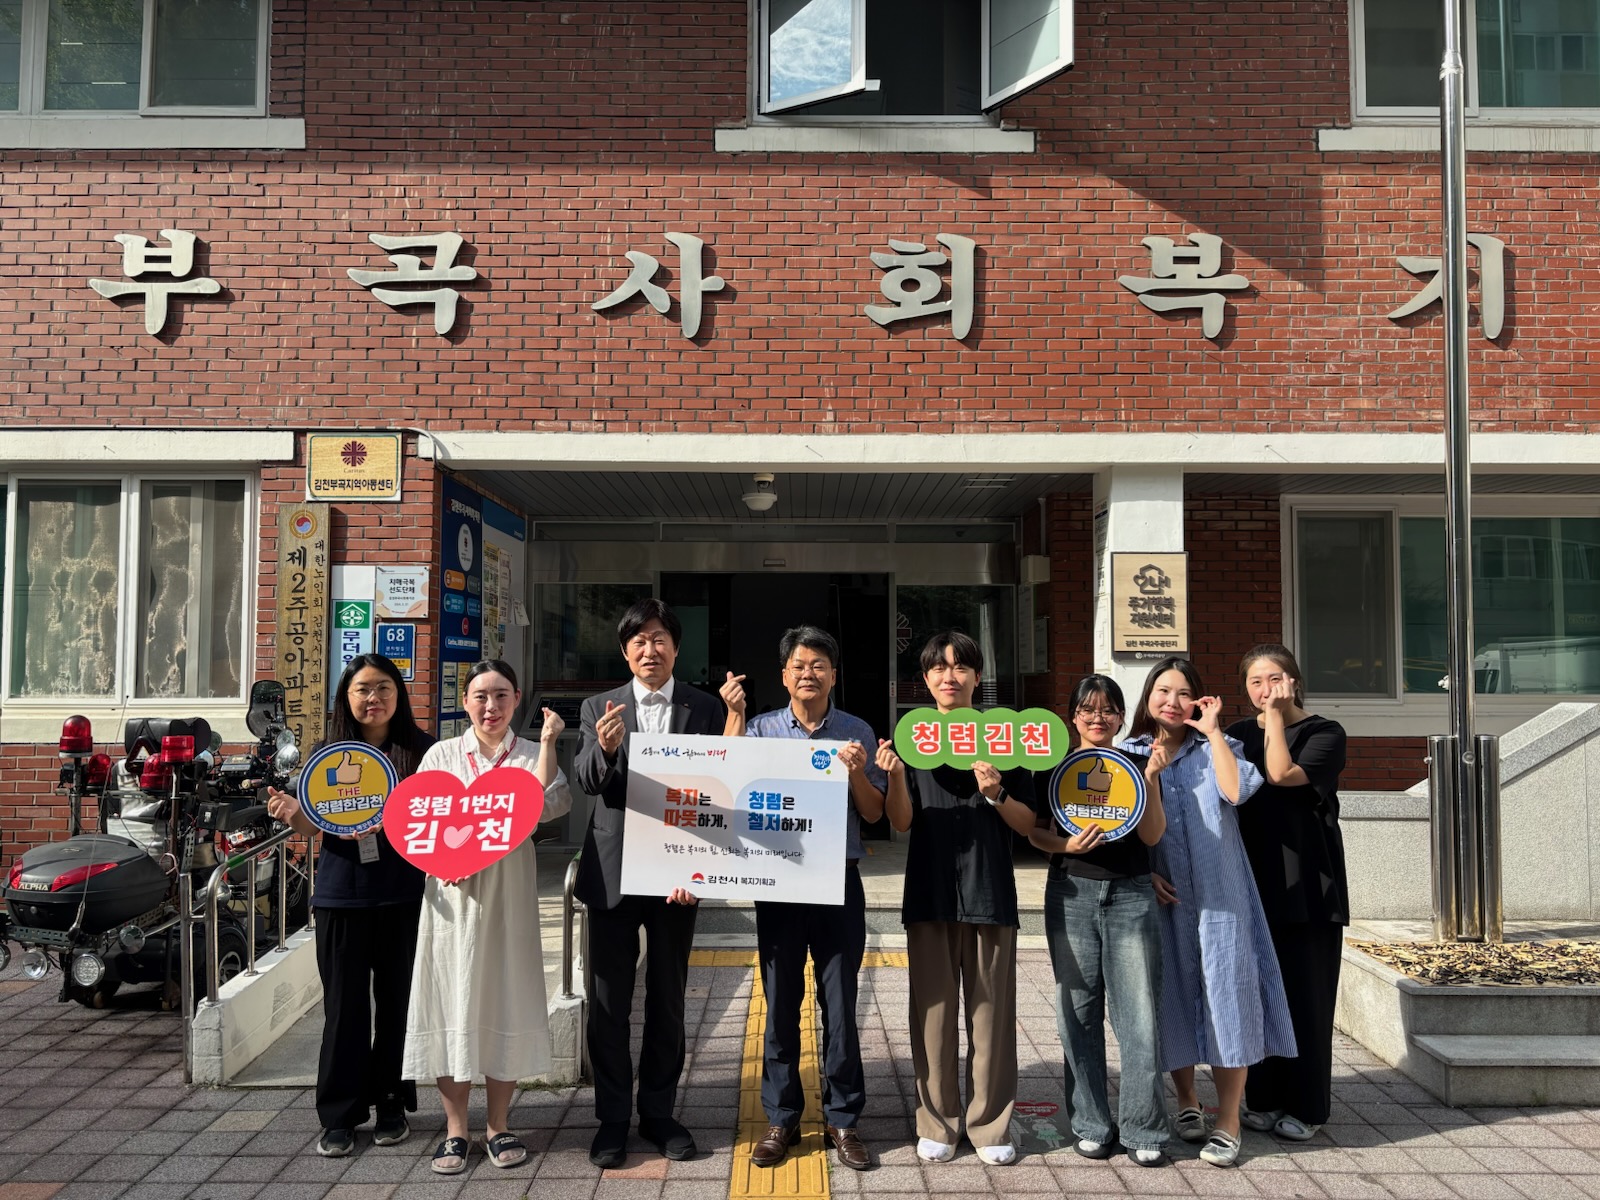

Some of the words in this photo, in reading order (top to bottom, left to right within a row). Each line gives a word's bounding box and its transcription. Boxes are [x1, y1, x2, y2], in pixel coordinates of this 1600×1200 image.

[314, 479, 393, 491] 김천부곡지역아동센터
[312, 539, 326, 608] 대한노인회
[389, 578, 415, 586] 치매극복
[389, 586, 415, 594] 선도단체
[1128, 596, 1176, 613] 주거행복
[1130, 612, 1176, 629] 지원센터
[285, 545, 310, 718] 제2주공아파트
[386, 628, 405, 642] 68
[311, 614, 323, 683] 김천시지회
[1125, 640, 1138, 648] 김천
[336, 786, 361, 797] THE
[665, 787, 712, 807] 복지는
[1086, 793, 1109, 805] THE
[315, 793, 385, 815] 청렴한김천
[408, 795, 453, 818] 청렴
[459, 792, 515, 815] 1번지
[748, 790, 795, 811] 청렴은
[663, 808, 728, 830] 따뜻하게,
[1064, 802, 1130, 822] 청렴한김천
[320, 820, 337, 832] 모두가
[337, 825, 355, 833] 만드는
[356, 820, 374, 831] 깨끗한
[747, 812, 813, 833] 철저하게!
[1117, 825, 1128, 835] 김천
[664, 842, 685, 854] 청렴은
[687, 844, 707, 856] 복지의
[743, 847, 763, 859] 복지의
[764, 848, 805, 860] 미래입니다.
[18, 882, 49, 891] ALPHA
[707, 874, 738, 886] 김천시
[740, 876, 776, 887] 복지기획과
